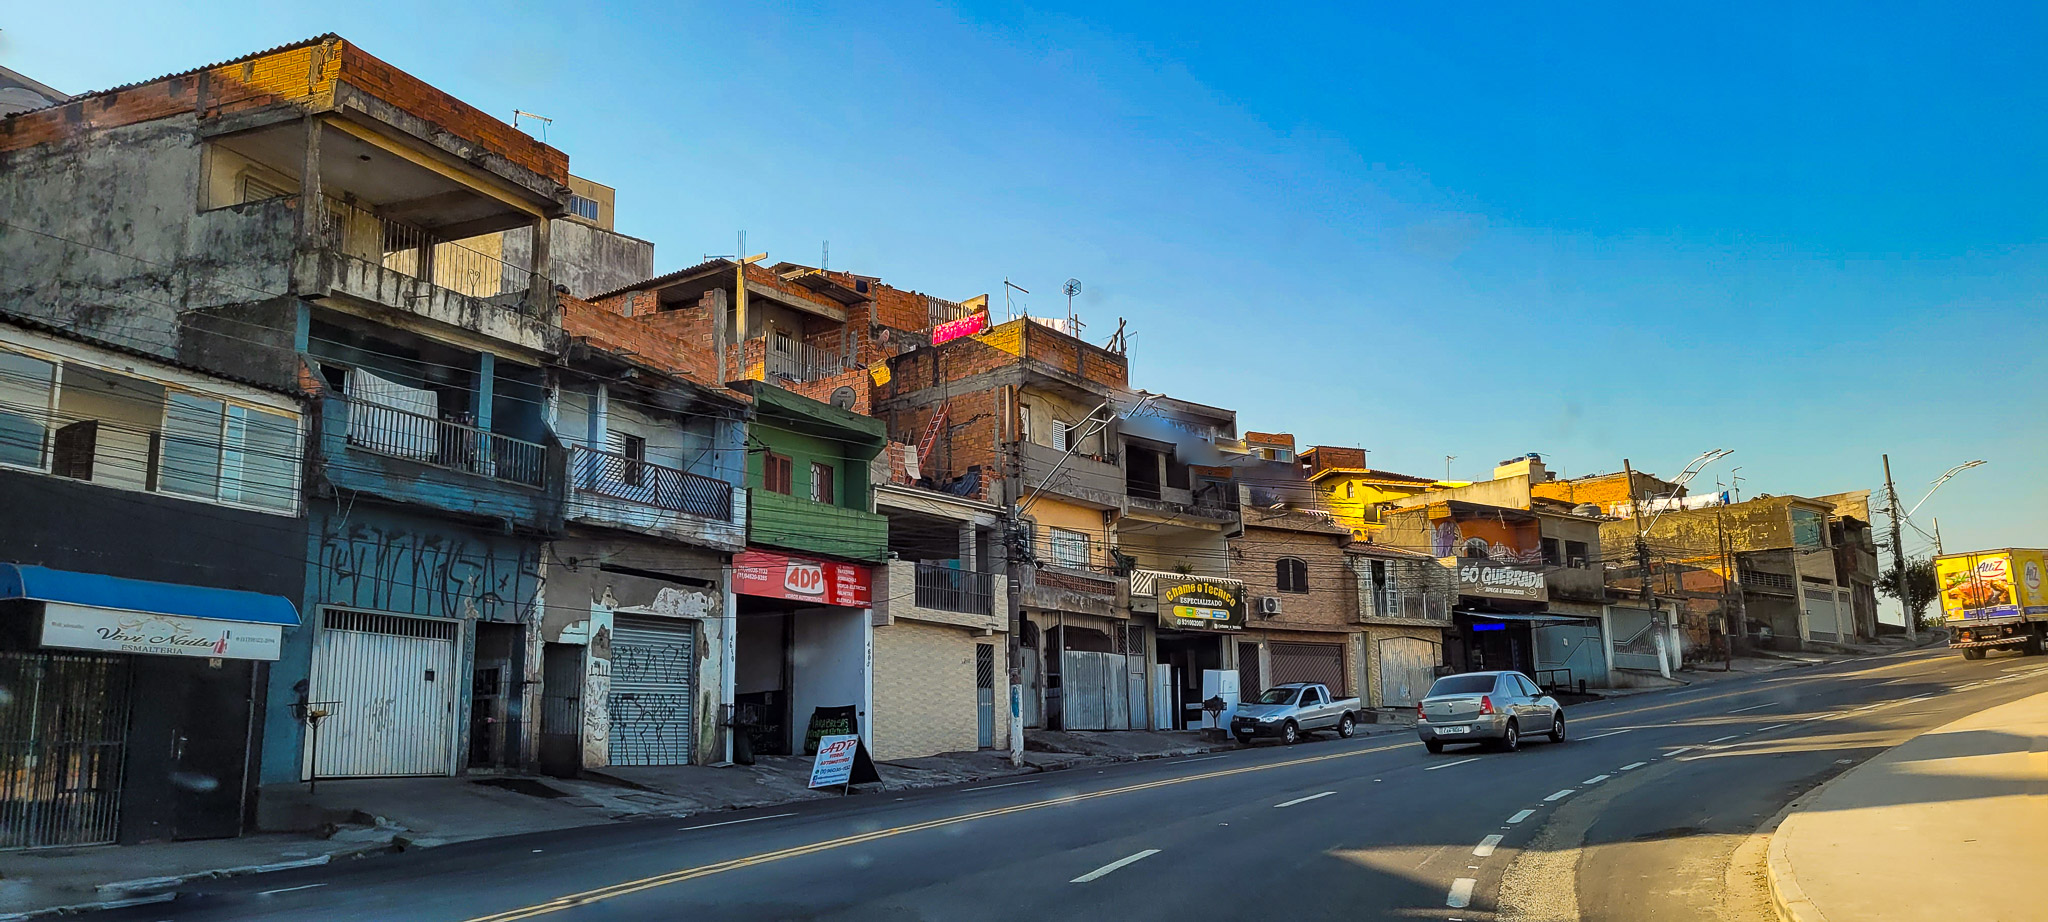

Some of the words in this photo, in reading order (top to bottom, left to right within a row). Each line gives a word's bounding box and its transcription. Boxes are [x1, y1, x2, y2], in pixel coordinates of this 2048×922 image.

[787, 567, 820, 590] ADP
[1460, 562, 1479, 583] SÓ
[1481, 567, 1544, 589] QUEBRADA
[1165, 583, 1196, 602] Chame
[1180, 597, 1223, 607] ESPECIALIZADO
[121, 644, 184, 655] ESMALTERIA
[820, 739, 857, 755] ADP
